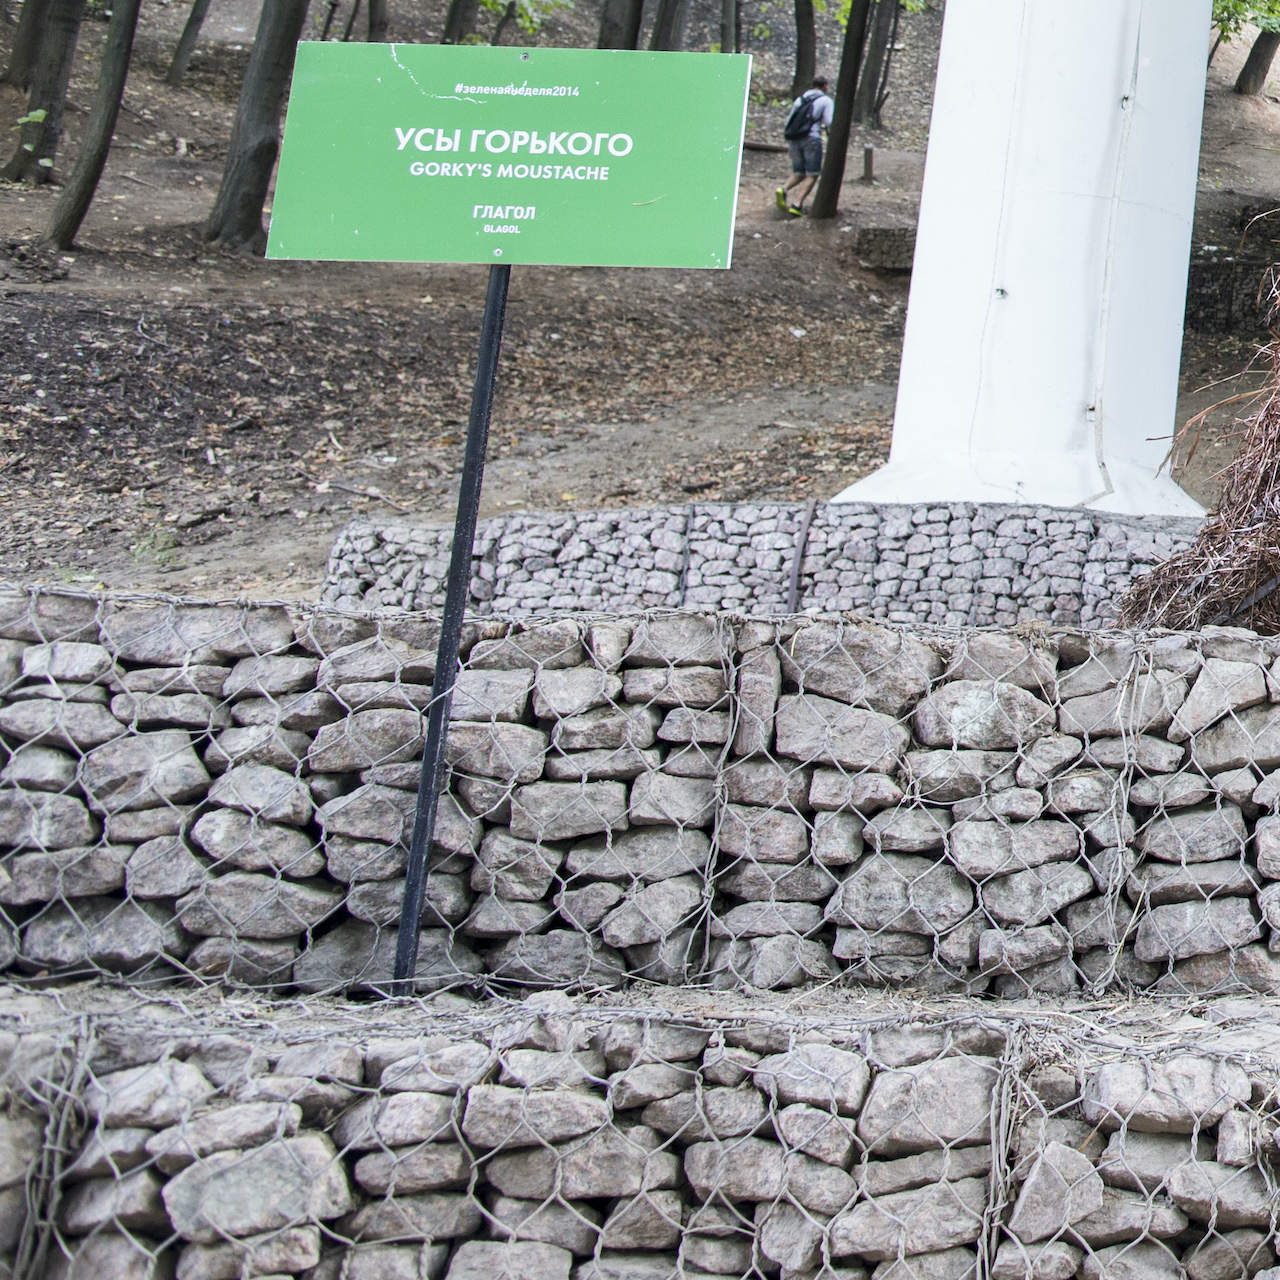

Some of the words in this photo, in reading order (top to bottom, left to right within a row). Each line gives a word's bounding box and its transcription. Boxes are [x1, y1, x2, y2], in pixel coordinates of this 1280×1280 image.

[394, 127, 461, 152] УСЫ
[469, 129, 633, 157] ГОРЬКОГО
[409, 161, 492, 178] GORKY'S
[496, 163, 609, 181] MOUSTACHE
[472, 204, 536, 220] ГЛАГОЛ
[483, 224, 521, 234] GLAGOL
